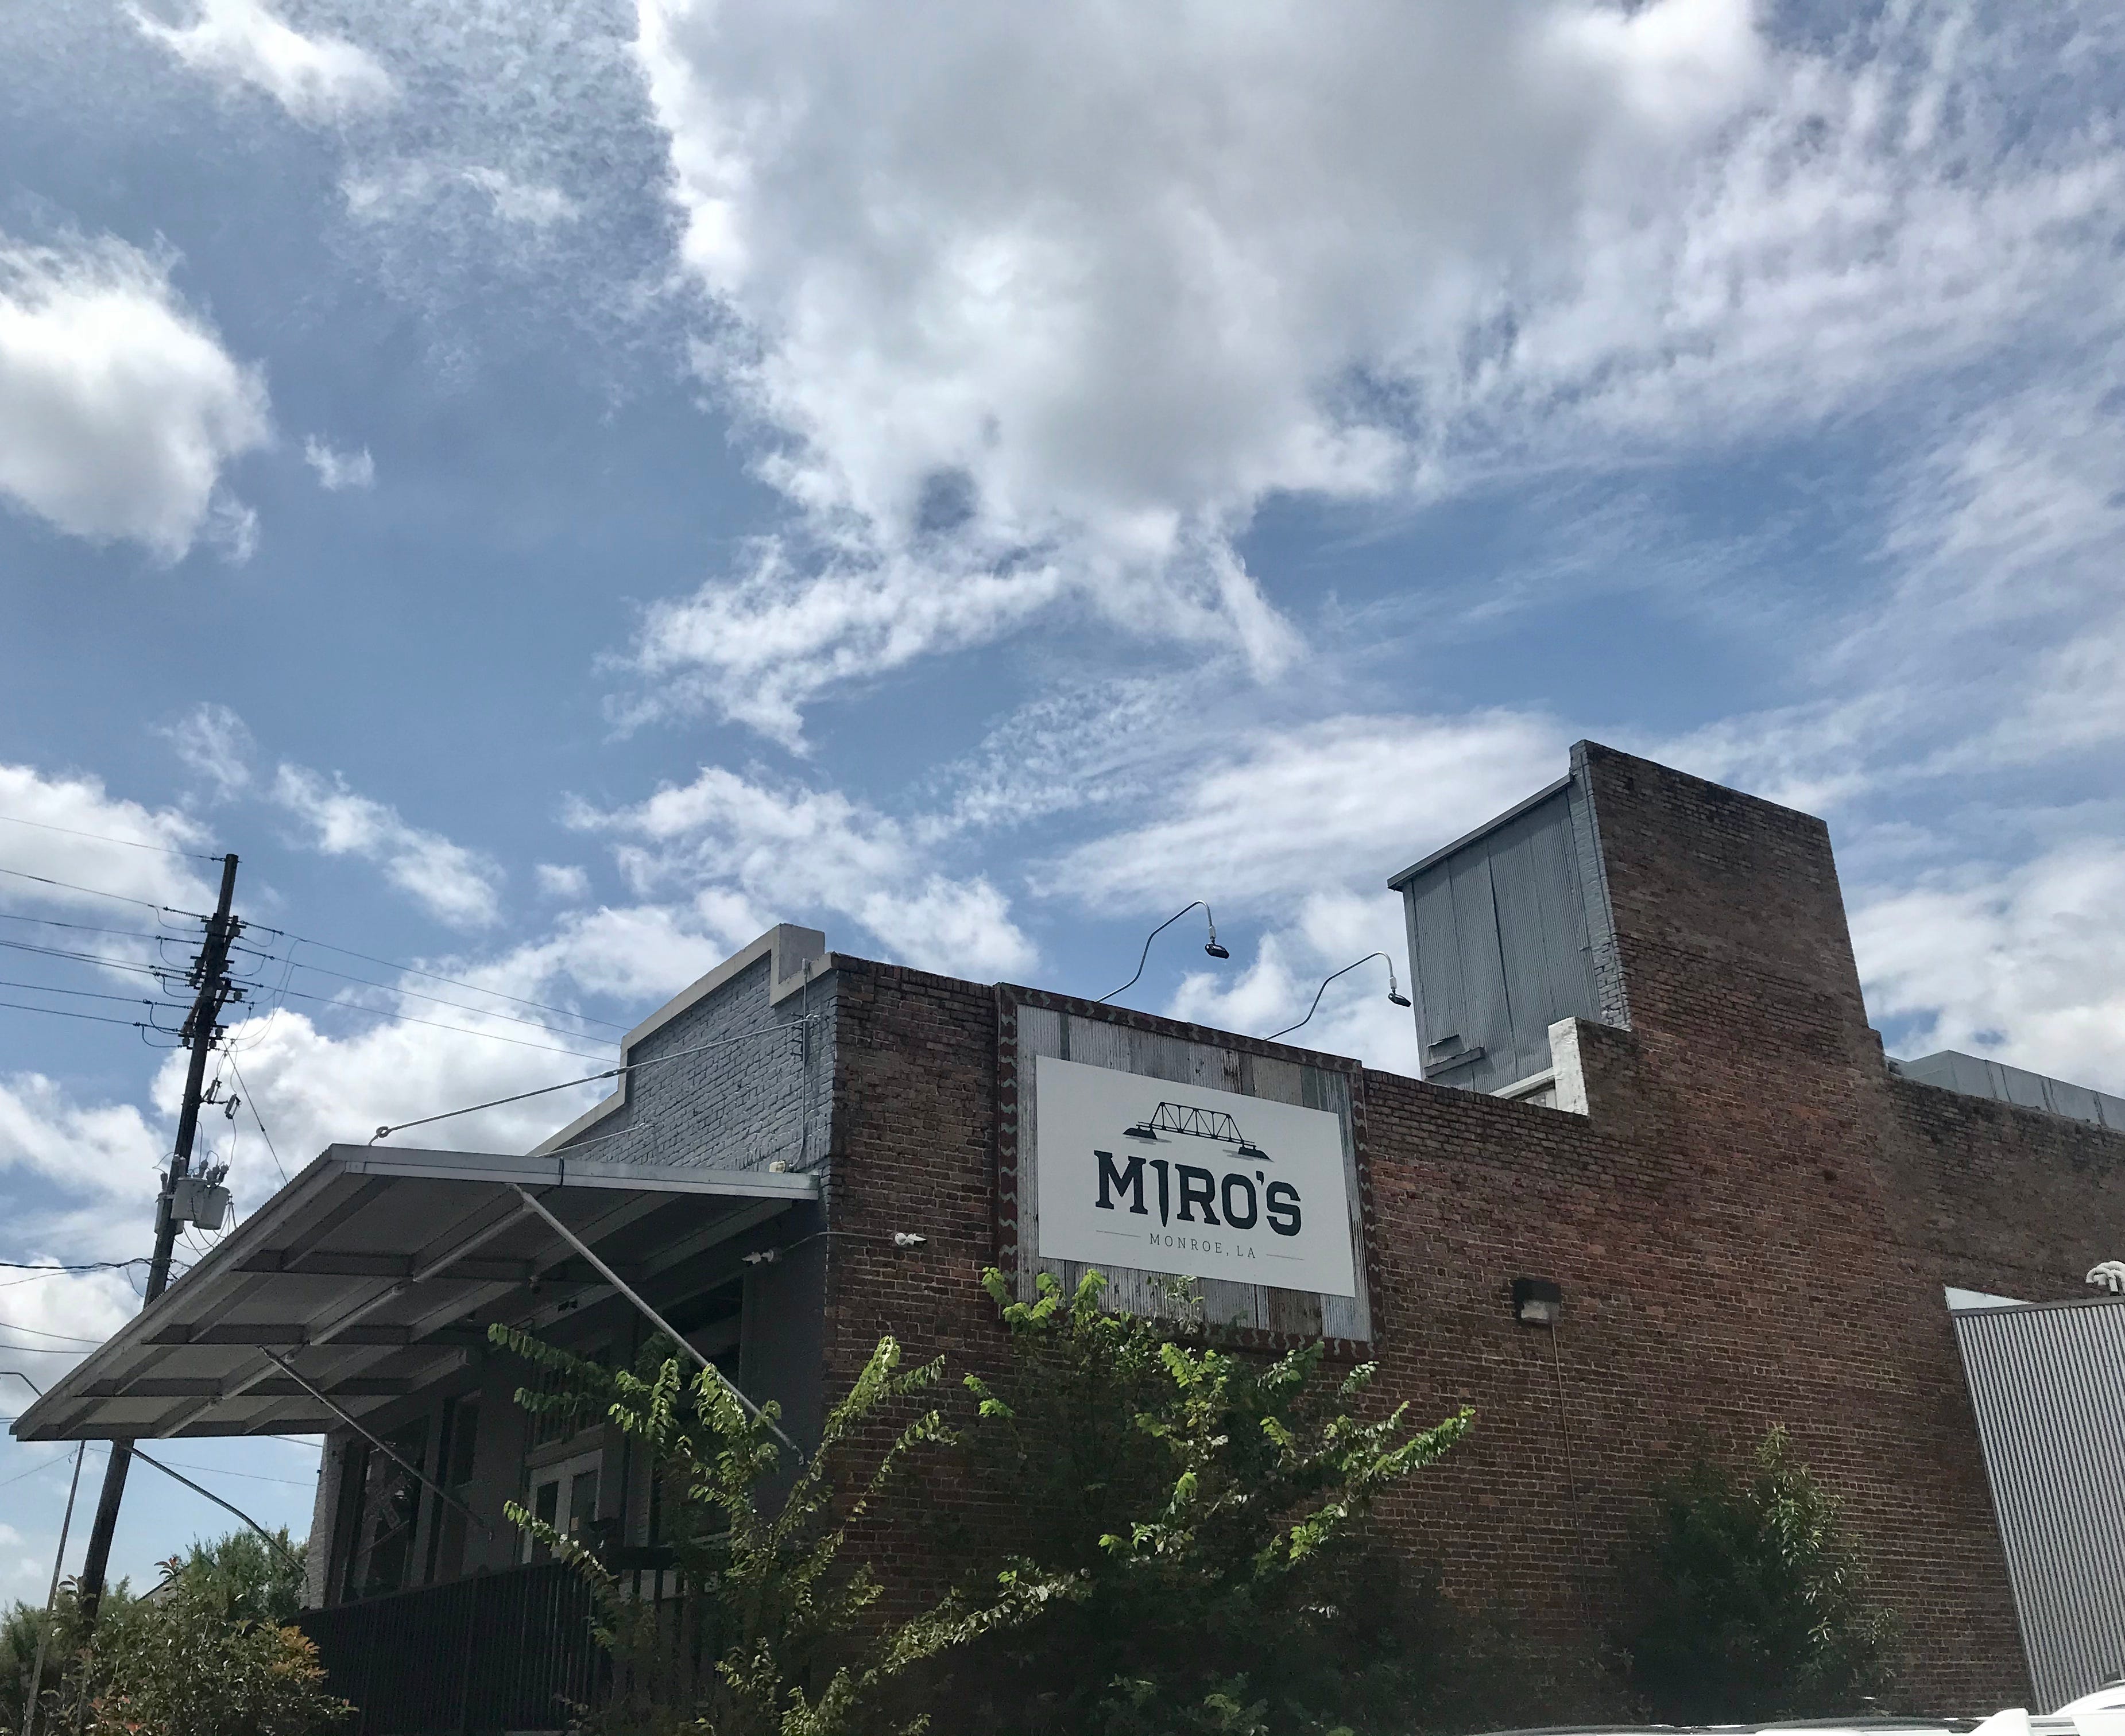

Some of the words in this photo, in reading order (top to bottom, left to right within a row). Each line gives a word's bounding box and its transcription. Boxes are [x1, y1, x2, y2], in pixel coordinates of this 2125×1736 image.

[1094, 1150, 1302, 1237] MIRO'S
[1149, 1233, 1229, 1257] MONROE,
[1236, 1245, 1256, 1259] LA
